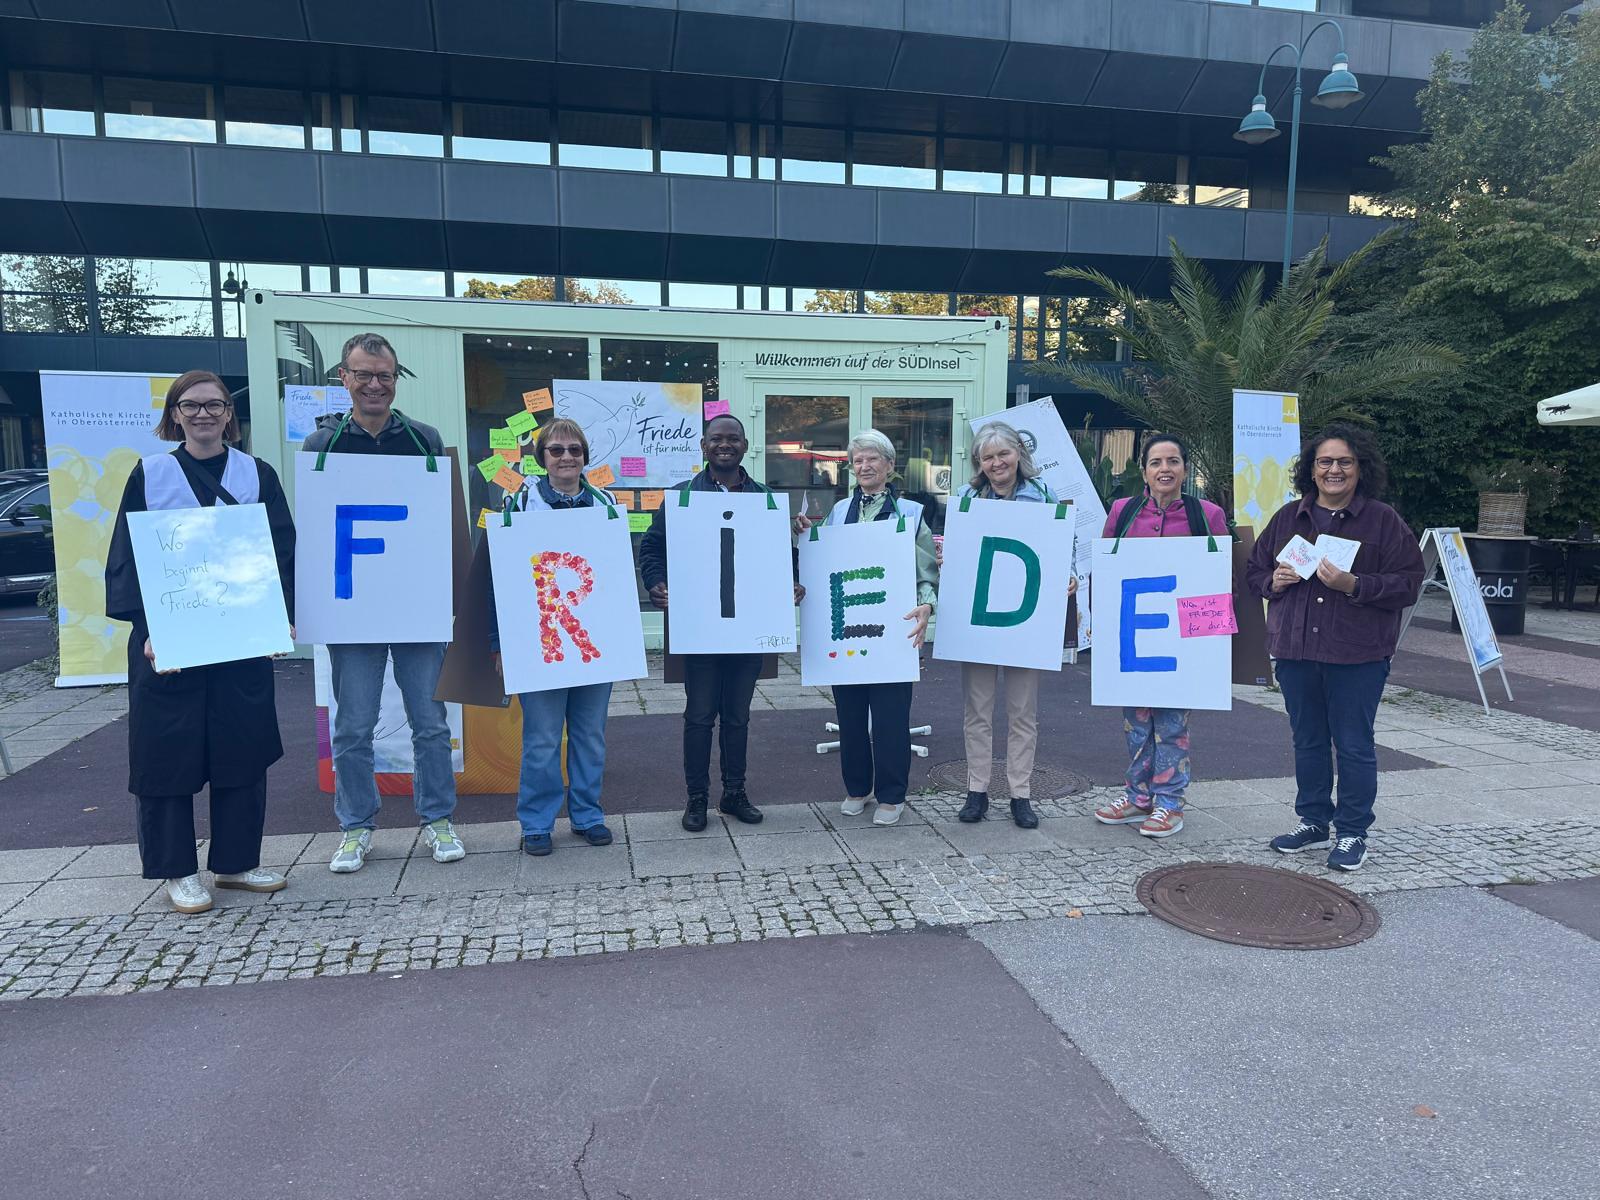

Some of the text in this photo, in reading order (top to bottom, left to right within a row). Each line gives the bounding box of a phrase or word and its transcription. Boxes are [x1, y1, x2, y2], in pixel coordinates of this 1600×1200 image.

[755, 353, 960, 370] Willkommen auf der SÜDInsel
[50, 411, 114, 419] Katholische
[71, 418, 152, 426] Oberösterreich
[636, 415, 697, 445] Friede
[643, 444, 654, 454] ist
[655, 441, 669, 456] für
[1043, 460, 1060, 470] Brot
[156, 523, 184, 552] Wo
[335, 504, 409, 600] F
[163, 551, 208, 587] beginnt
[970, 535, 1041, 628] D
[531, 551, 602, 664] R
[829, 566, 887, 642] E
[1120, 575, 1178, 673] E
